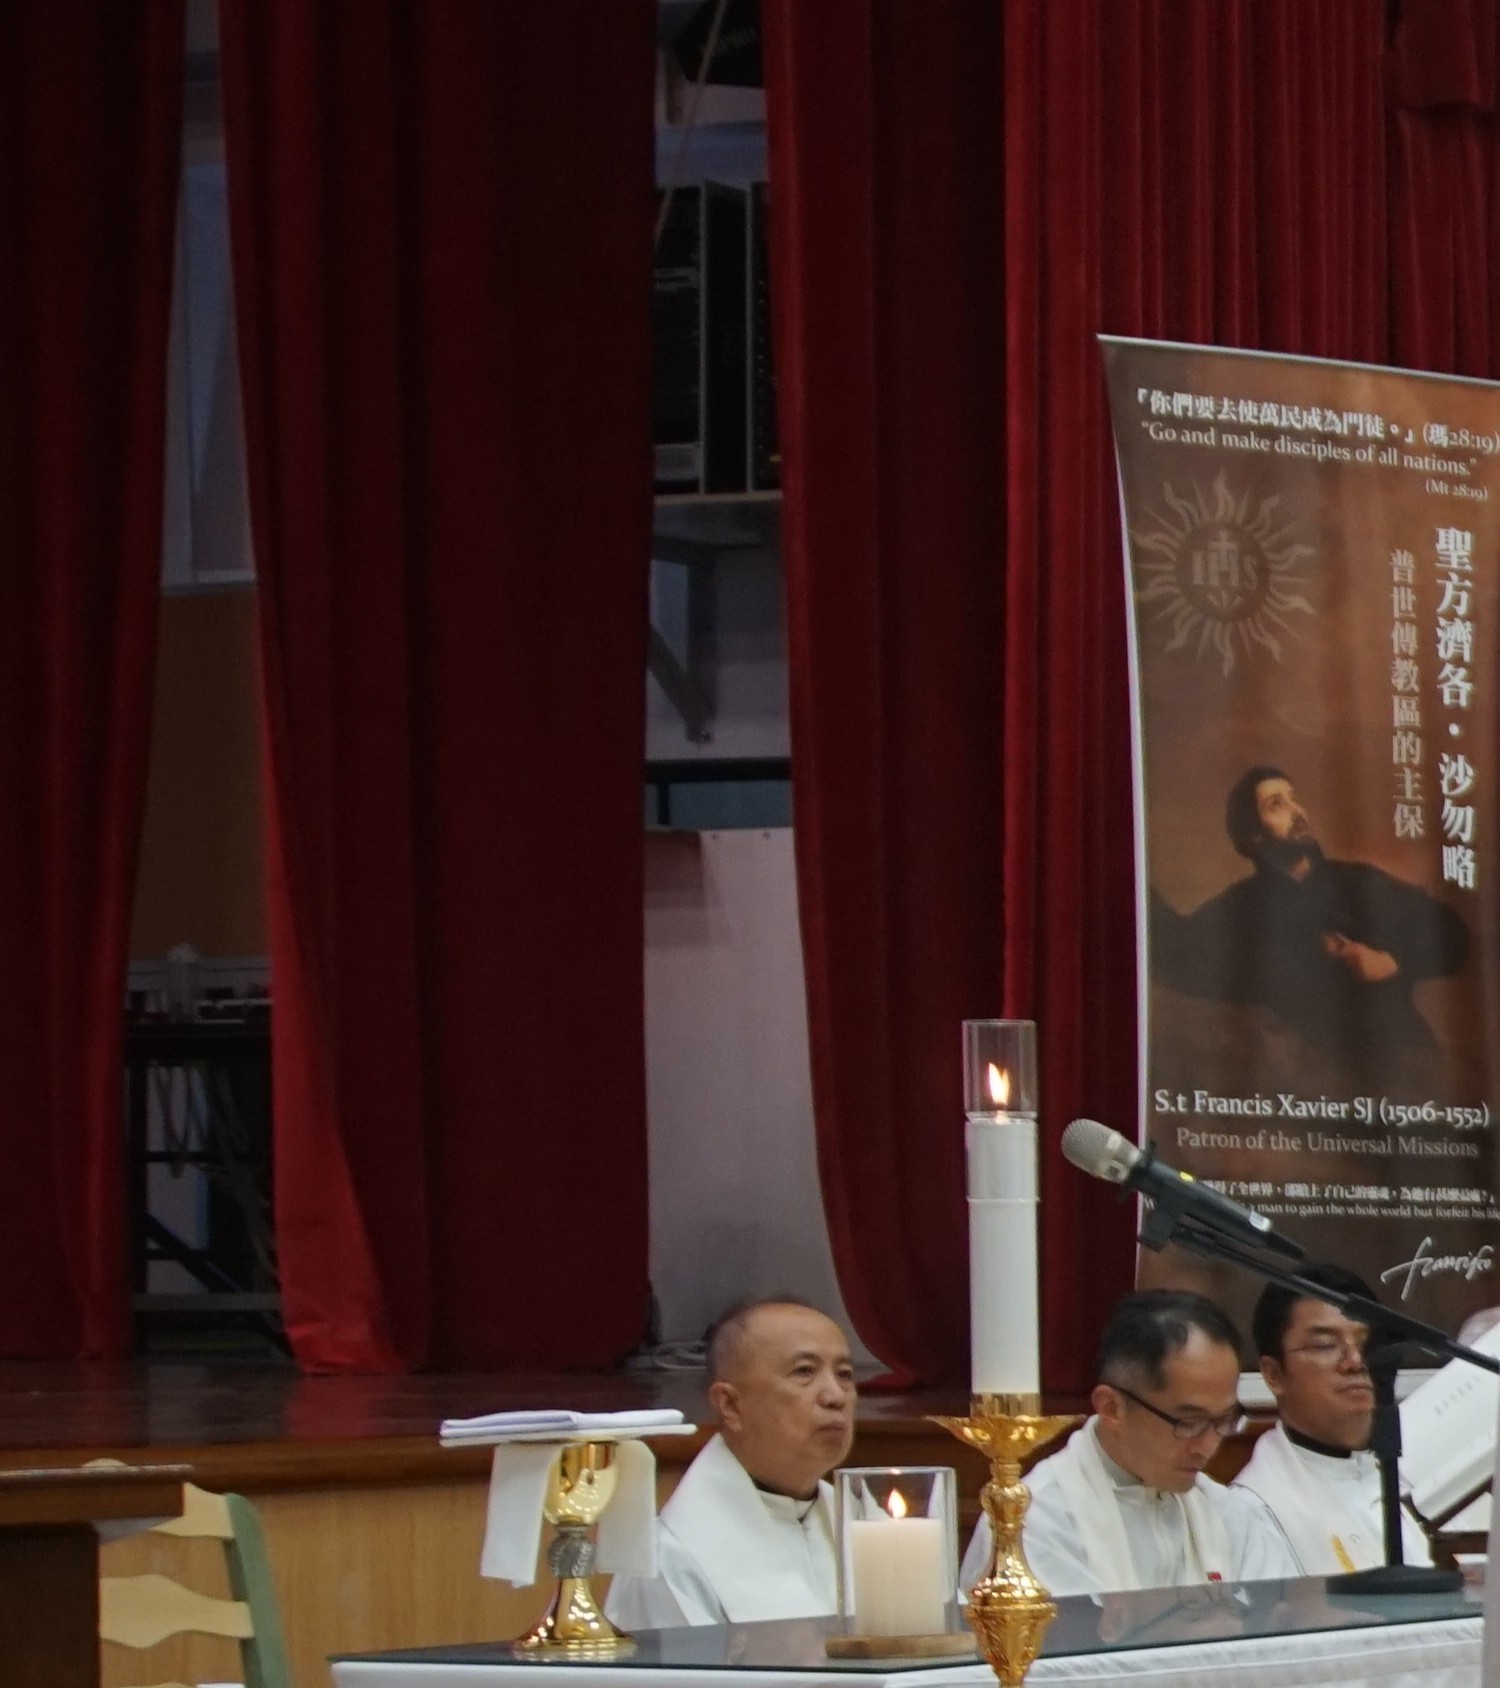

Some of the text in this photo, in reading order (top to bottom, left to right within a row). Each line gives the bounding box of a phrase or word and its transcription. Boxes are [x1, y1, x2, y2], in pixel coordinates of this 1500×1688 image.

[1180, 426, 1216, 446] and
[1222, 431, 1271, 452] make
[1274, 434, 1351, 463] disciples
[1355, 440, 1375, 462] of
[1378, 447, 1398, 466] all
[1389, 548, 1425, 840] 普世傳教區的主保
[1154, 1088, 1490, 1129] S.t Francis Xavier SJ (1506-1552)
[1176, 1127, 1479, 1158] Patron of the Universal Missions
[1257, 1203, 1284, 1214] man
[1285, 1202, 1298, 1214] to
[1299, 1203, 1324, 1217] gain
[1325, 1202, 1345, 1215] the
[1347, 1203, 1379, 1216] whole
[1380, 1203, 1412, 1217] world
